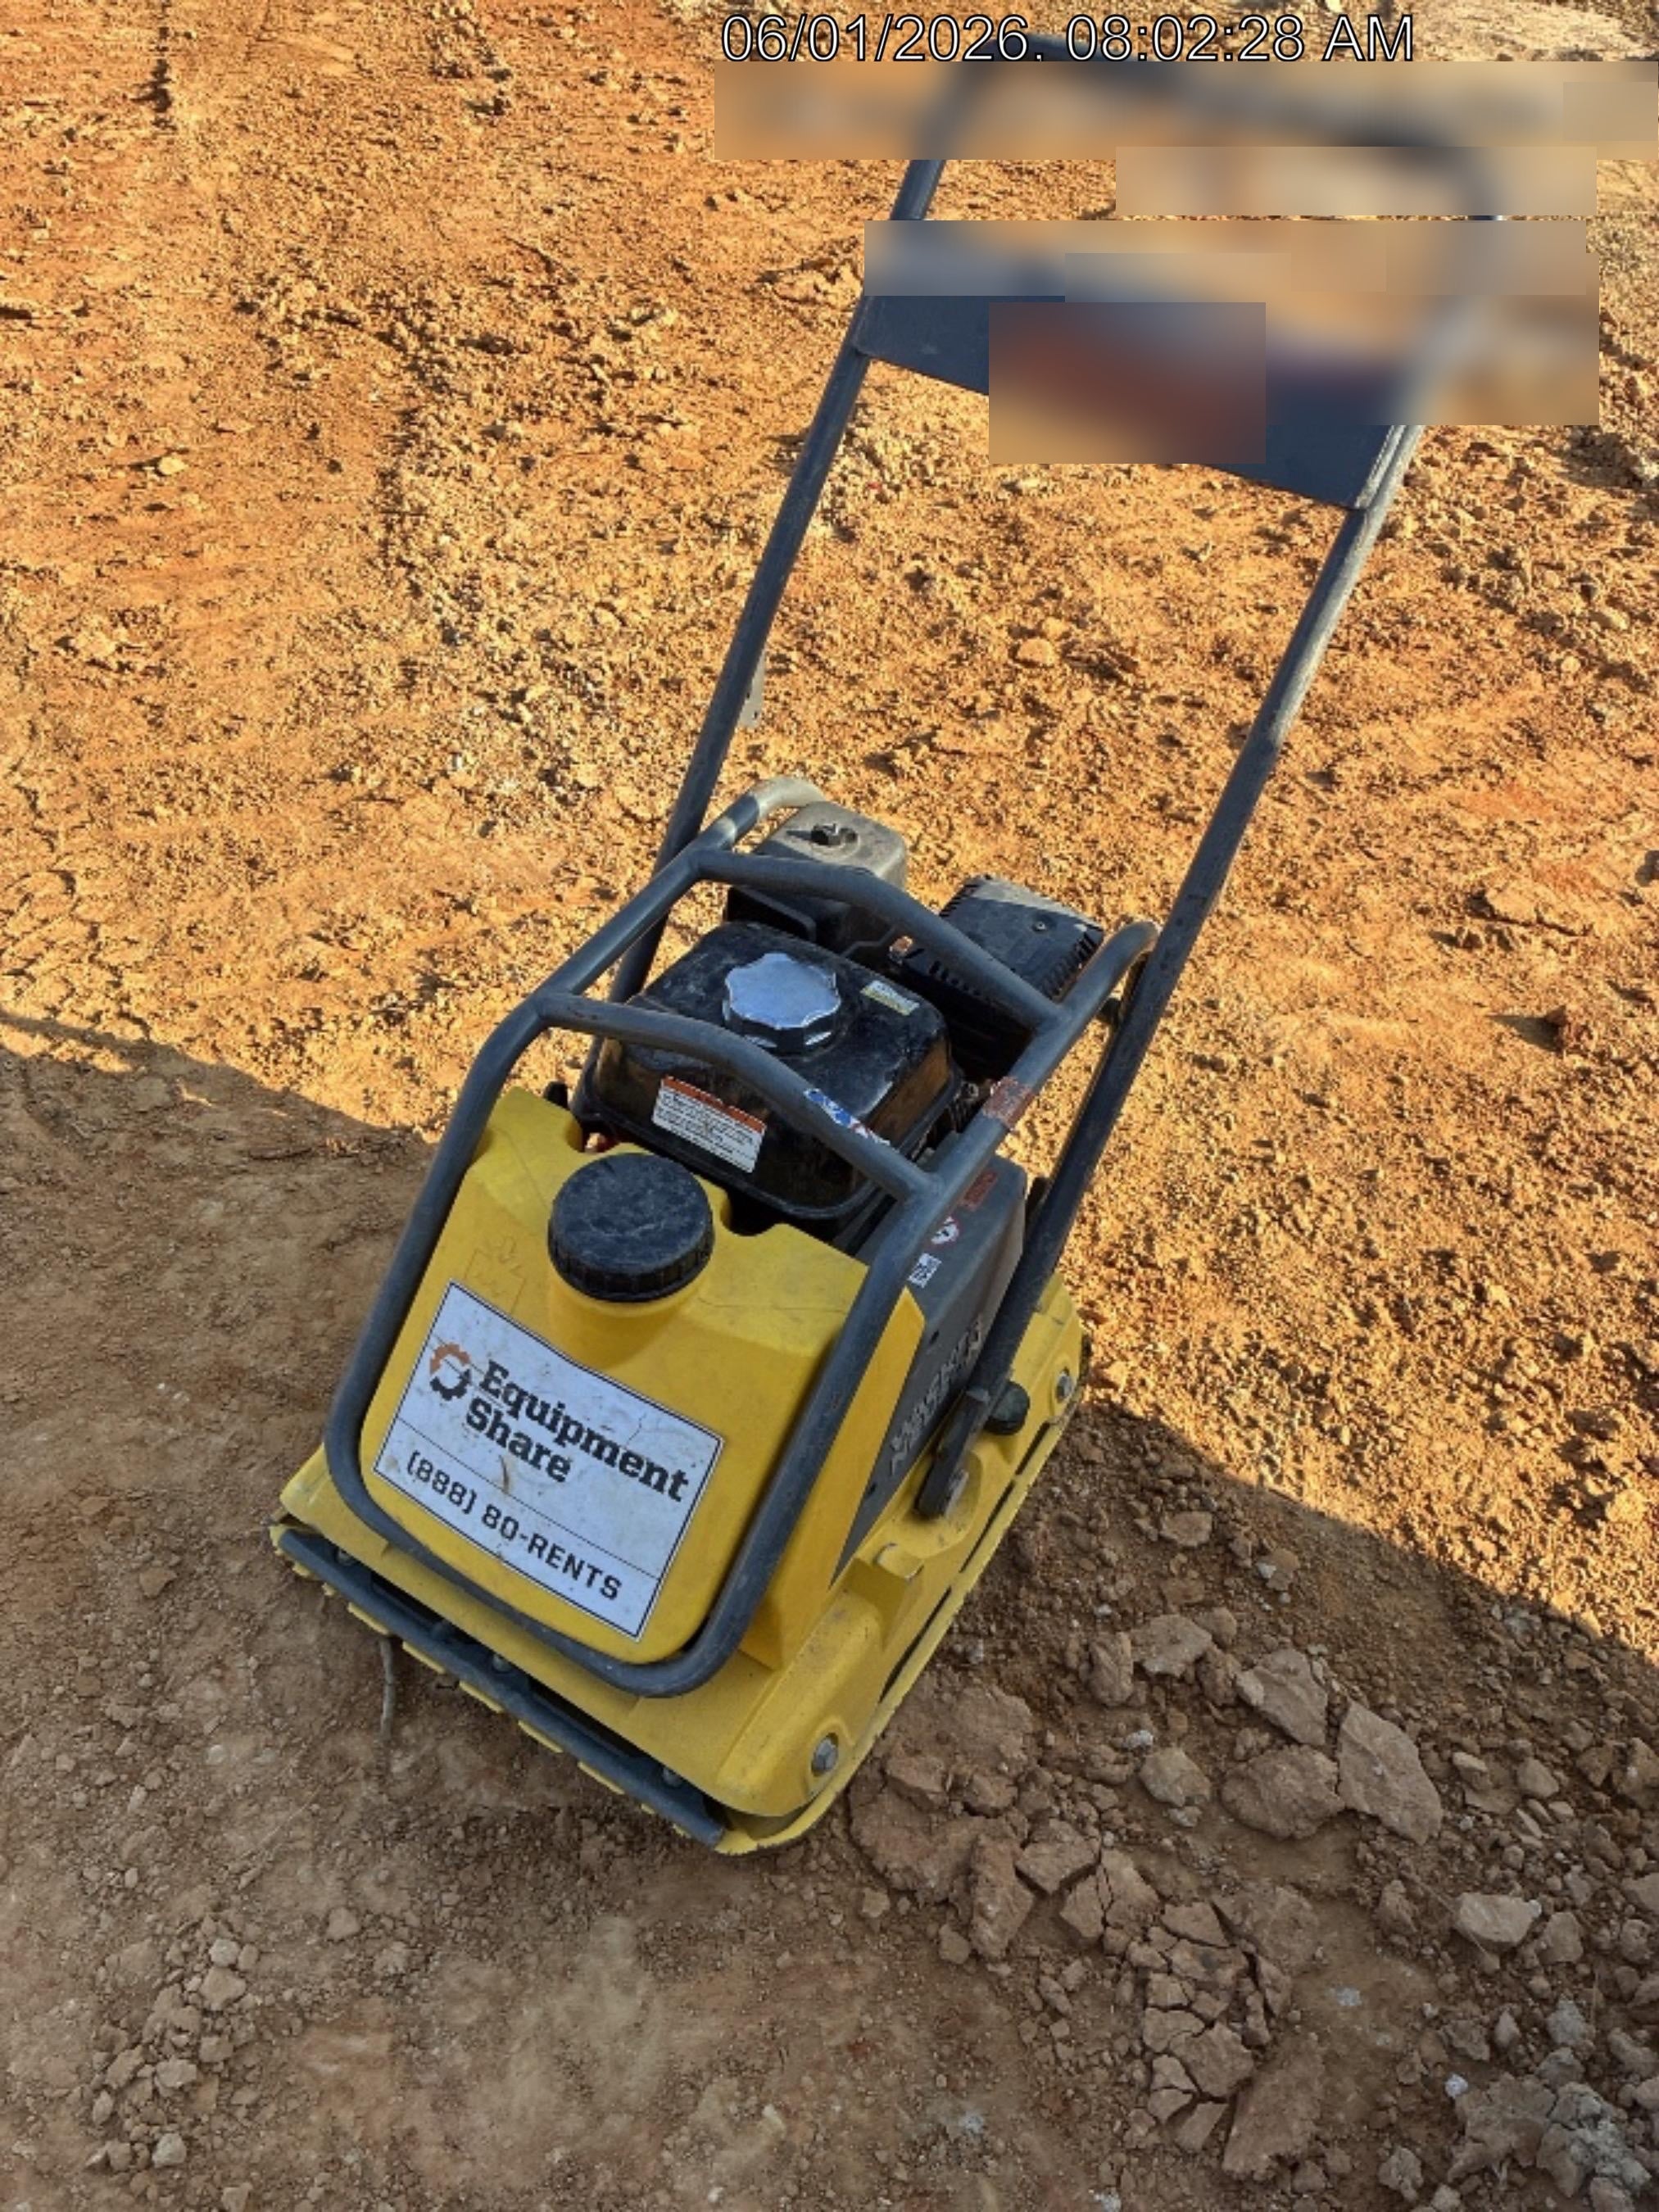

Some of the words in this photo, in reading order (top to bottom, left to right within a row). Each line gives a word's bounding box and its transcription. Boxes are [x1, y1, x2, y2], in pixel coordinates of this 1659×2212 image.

[465, 1397, 573, 1483] Share
[478, 1360, 689, 1503] Equipment
[407, 1450, 477, 1515] (888)
[482, 1505, 623, 1601] 80-RENTS
